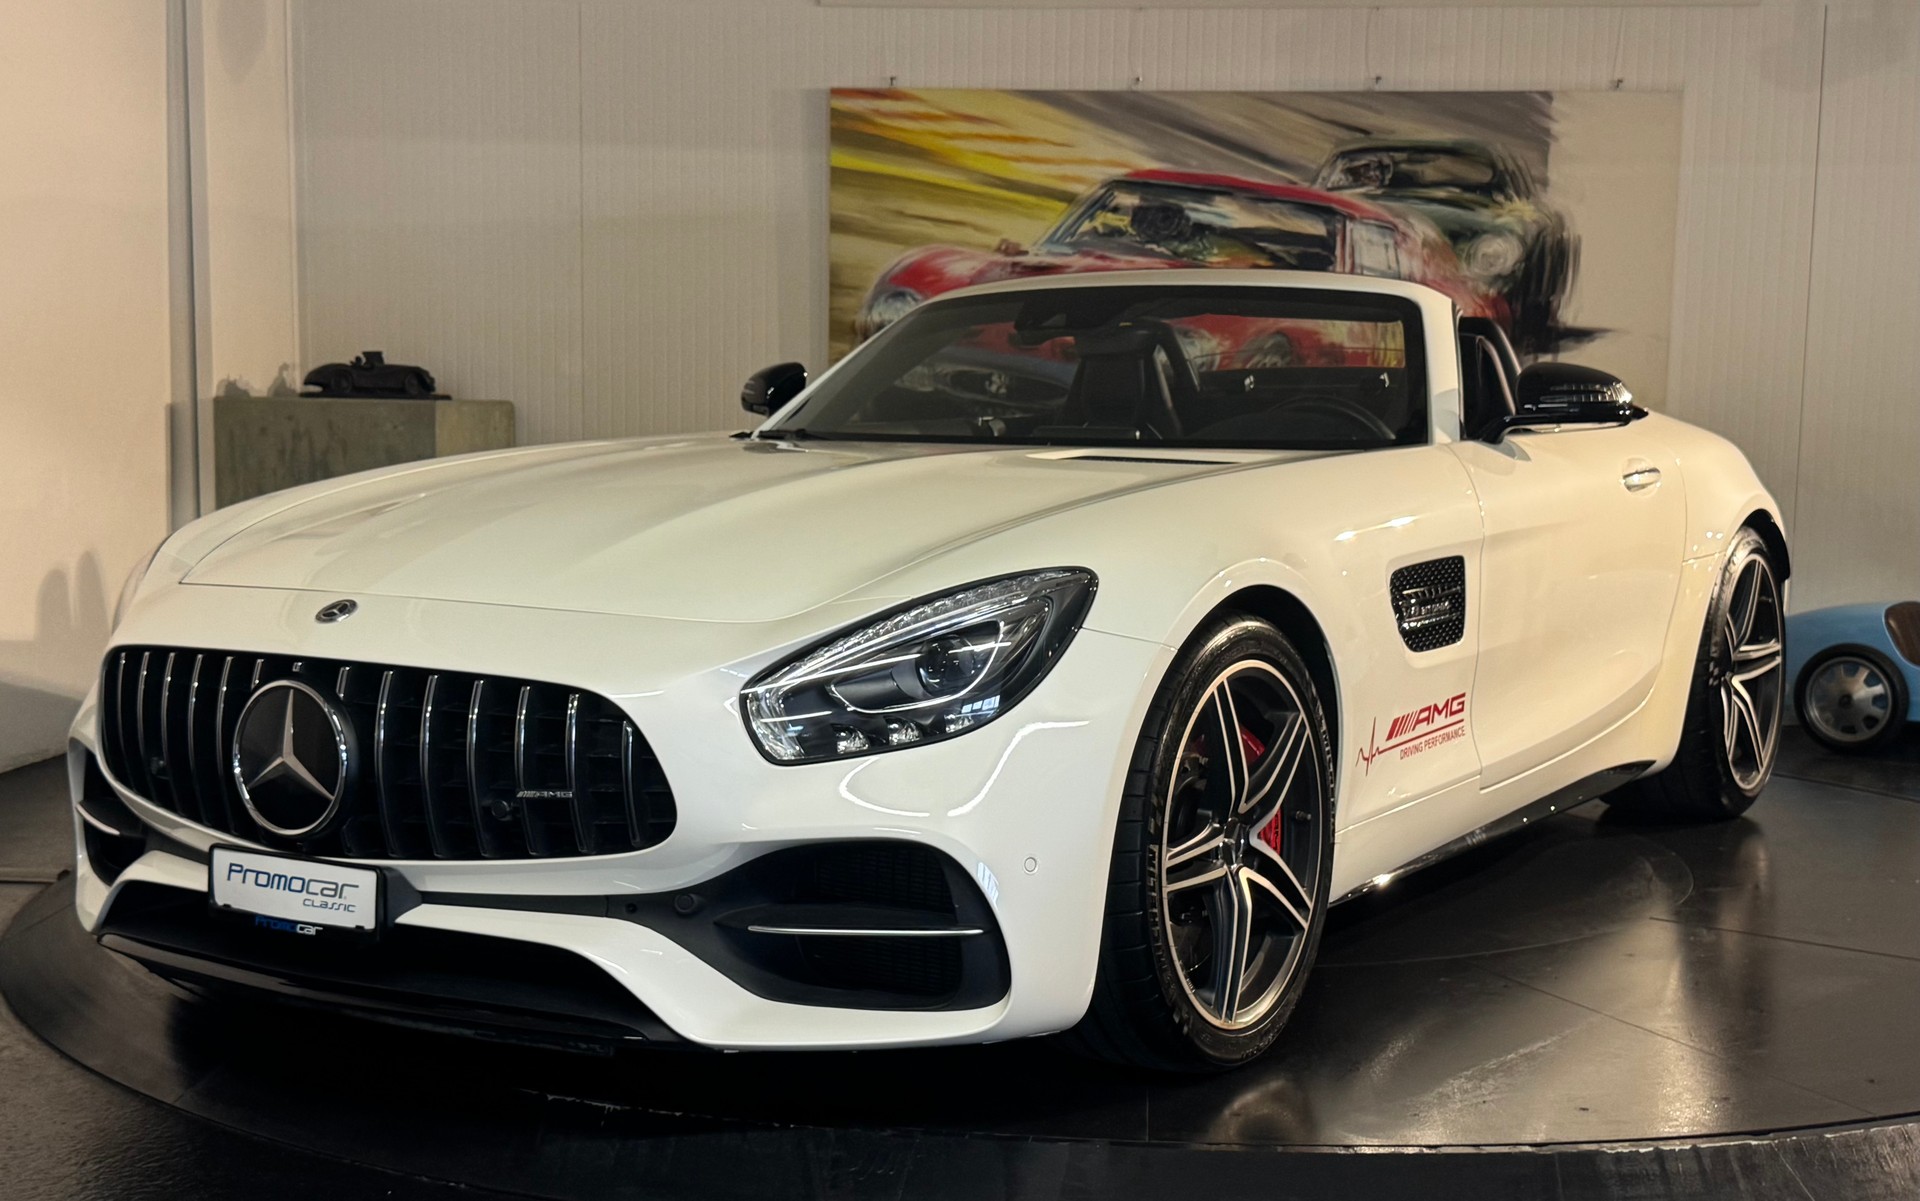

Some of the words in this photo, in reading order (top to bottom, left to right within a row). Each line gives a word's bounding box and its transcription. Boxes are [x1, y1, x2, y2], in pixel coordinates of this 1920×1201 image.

[1411, 692, 1466, 732] AMG
[1399, 741, 1424, 760] DRIVING
[1424, 725, 1466, 752] PERFORMANCE
[536, 790, 573, 798] AMG
[227, 862, 359, 899] Promocar
[255, 915, 323, 936] Promocar
